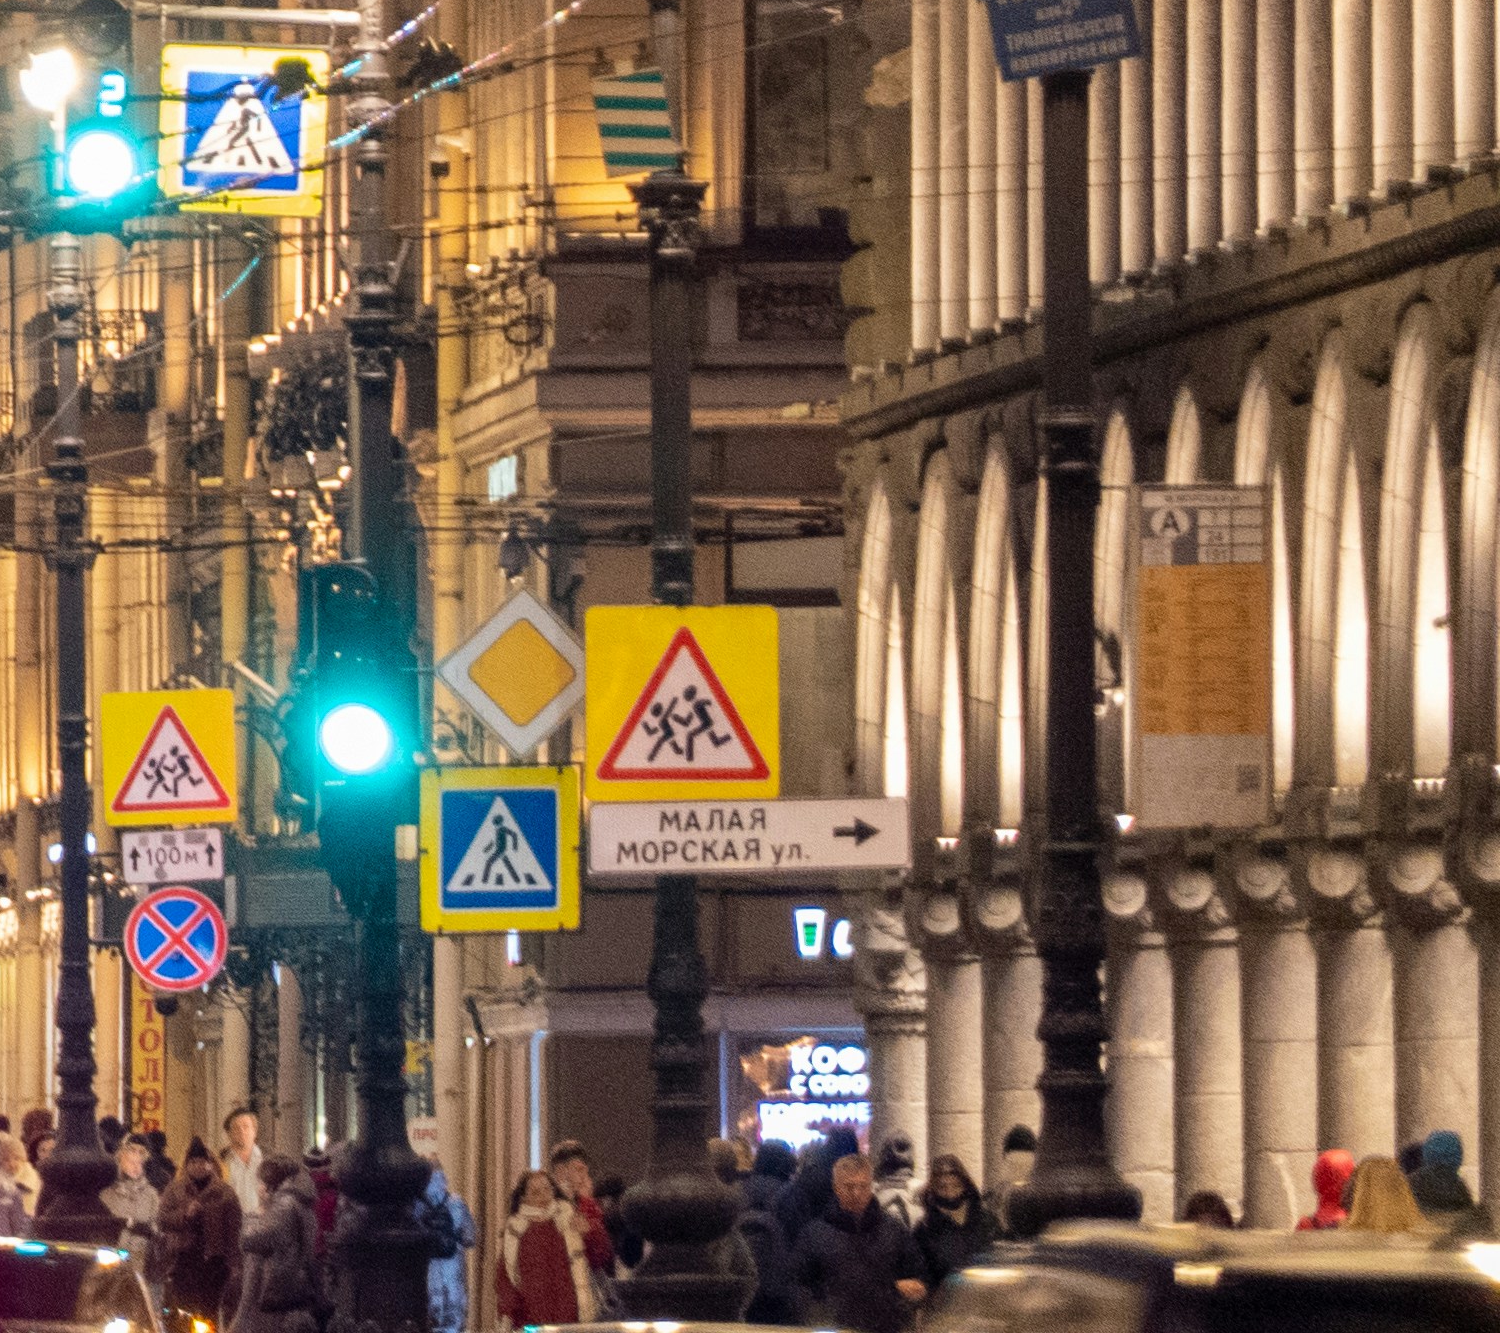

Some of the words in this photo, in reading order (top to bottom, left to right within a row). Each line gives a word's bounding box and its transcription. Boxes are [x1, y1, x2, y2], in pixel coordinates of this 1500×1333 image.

[658, 807, 767, 833] МАЛАЯ
[616, 838, 762, 864] МОРСКАЯ
[771, 843, 811, 866] ул.
